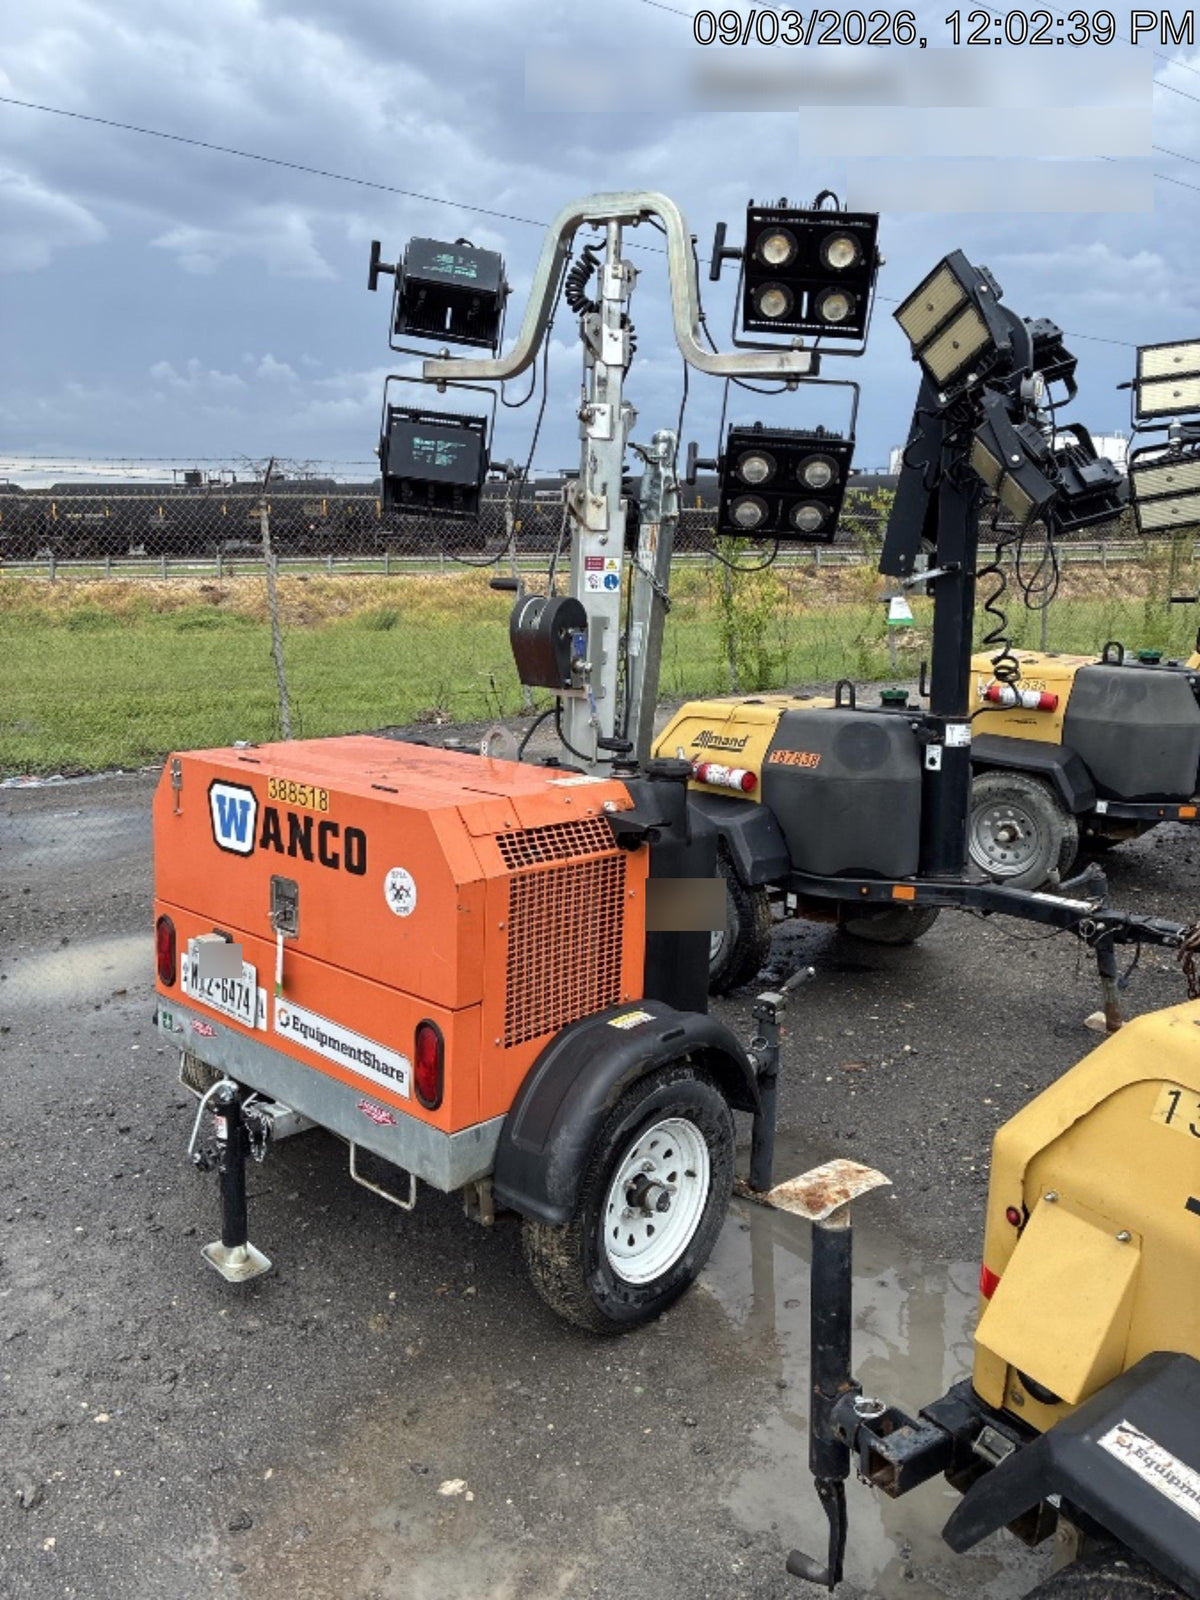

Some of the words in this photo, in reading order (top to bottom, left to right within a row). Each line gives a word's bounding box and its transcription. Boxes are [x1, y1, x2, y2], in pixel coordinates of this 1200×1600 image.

[691, 730, 749, 752] Allmand
[269, 777, 329, 812] 388518
[215, 793, 367, 876] WANCO
[291, 1014, 405, 1084] EquipmentShare
